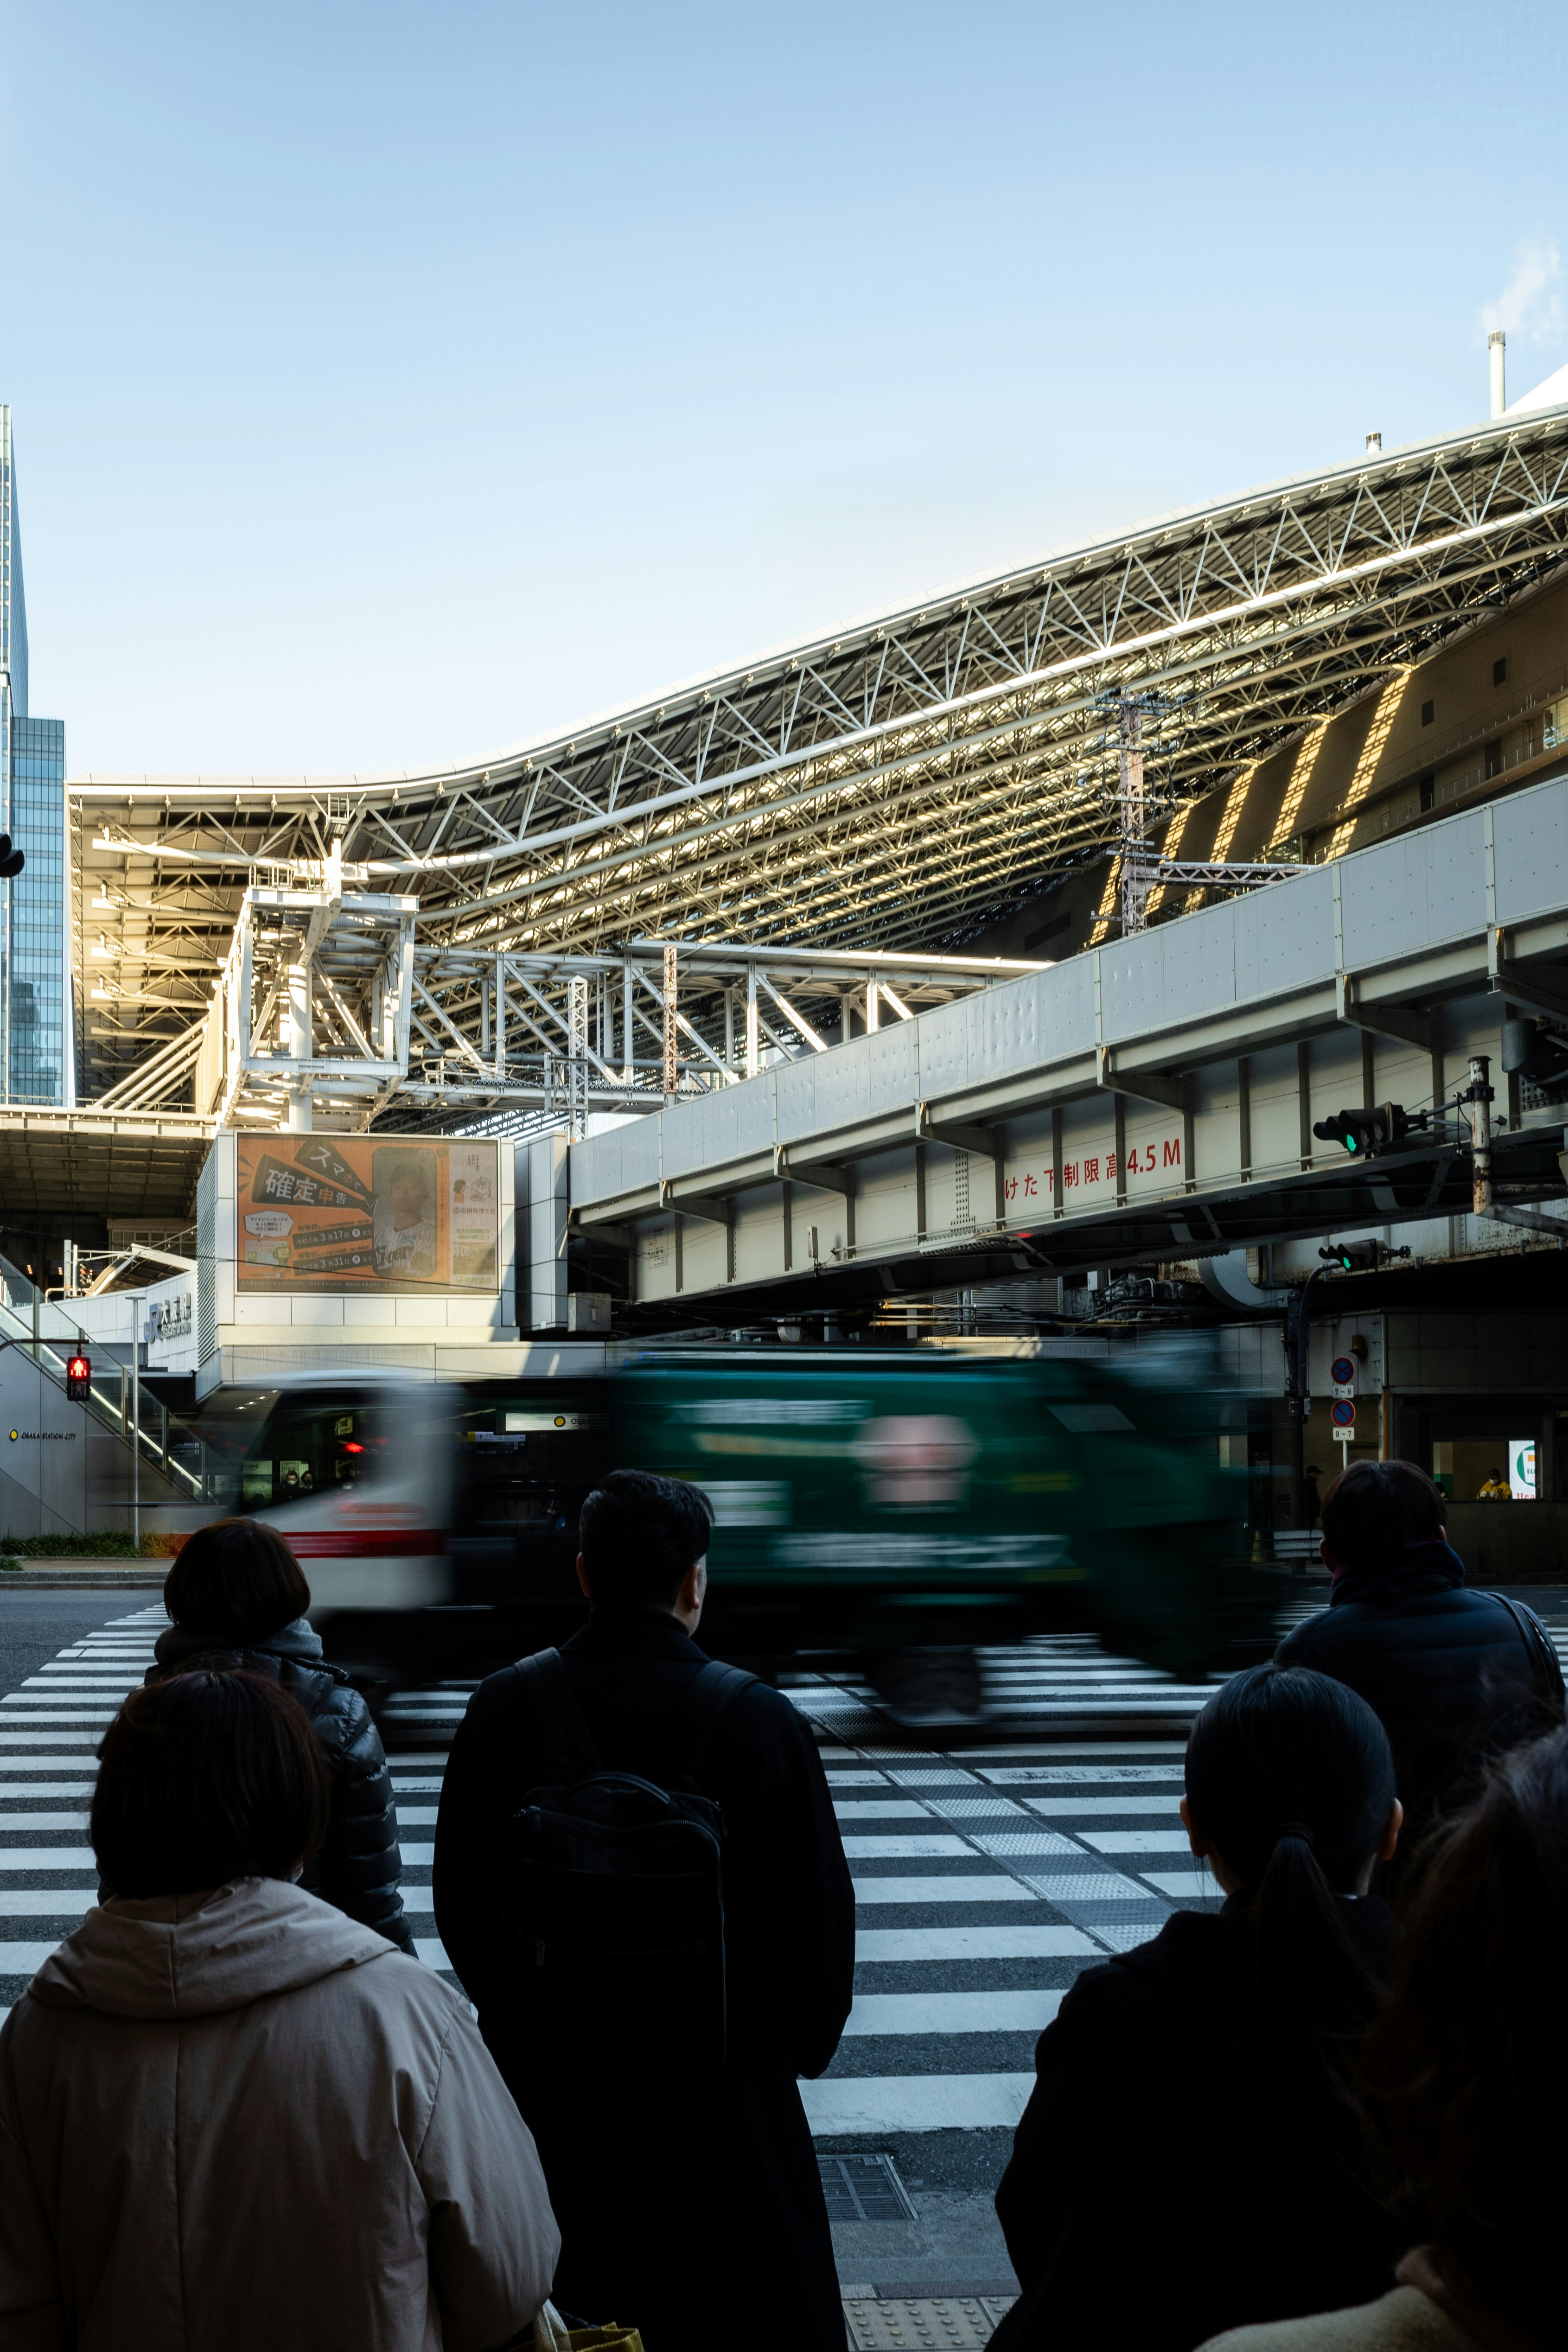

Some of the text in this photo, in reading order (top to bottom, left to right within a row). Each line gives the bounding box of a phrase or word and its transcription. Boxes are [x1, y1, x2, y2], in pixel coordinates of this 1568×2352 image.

[265, 1169, 347, 1204] 確定申告
[310, 1146, 361, 1190] スマホで
[144, 1303, 161, 1343] JR
